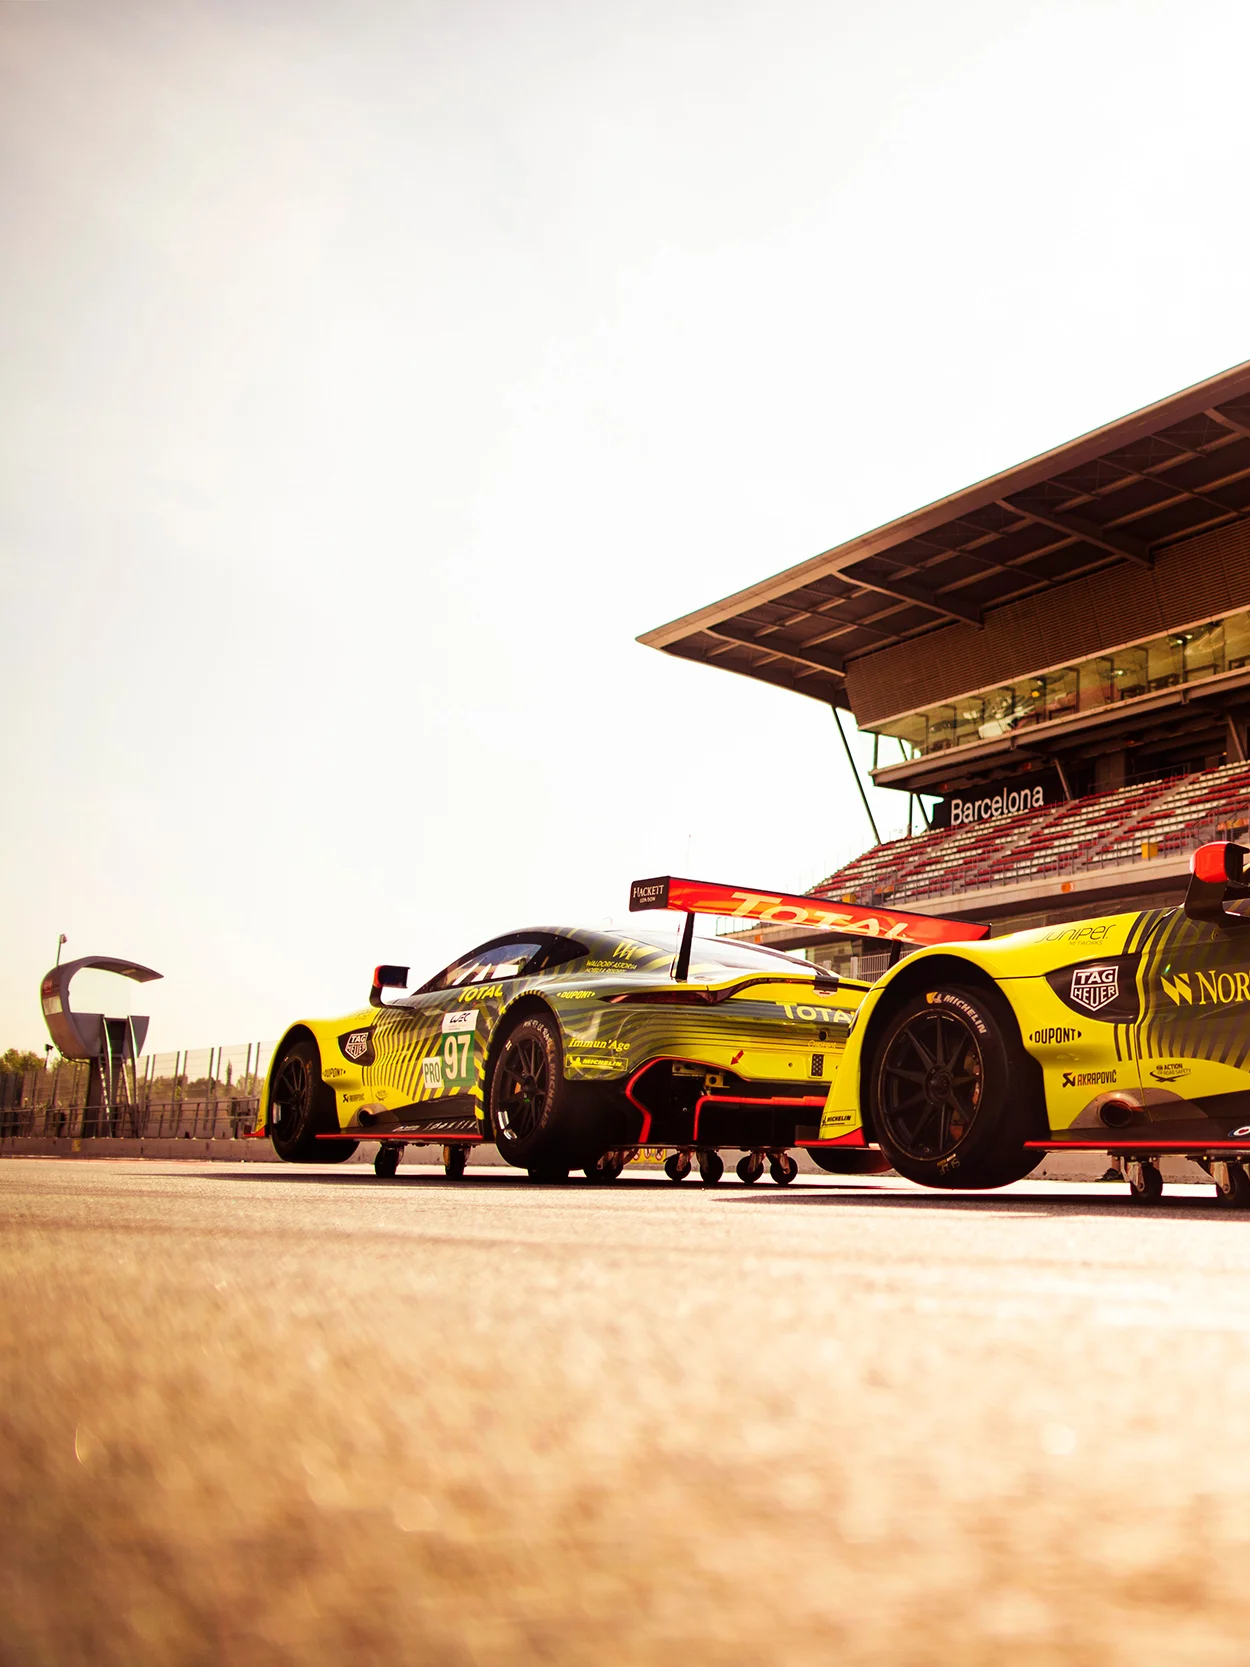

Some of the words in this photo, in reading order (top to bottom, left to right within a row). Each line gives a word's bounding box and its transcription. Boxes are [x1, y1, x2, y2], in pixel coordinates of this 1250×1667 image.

[951, 785, 1044, 827] Barcelona
[633, 885, 664, 898] HACKETT
[731, 891, 914, 942] TOTAL
[1077, 970, 1114, 985] TAG
[458, 984, 504, 1003] TOTAL
[560, 990, 592, 999] DUPONT
[1074, 986, 1116, 1007] HEUER
[449, 1012, 471, 1024] WEC
[943, 994, 988, 1034] MICHELIN
[351, 1034, 366, 1043] TAG
[1034, 1027, 1076, 1044] DUPONT
[444, 1034, 471, 1080] 97
[582, 1058, 623, 1067] MICHELIN
[424, 1061, 441, 1084] PRO
